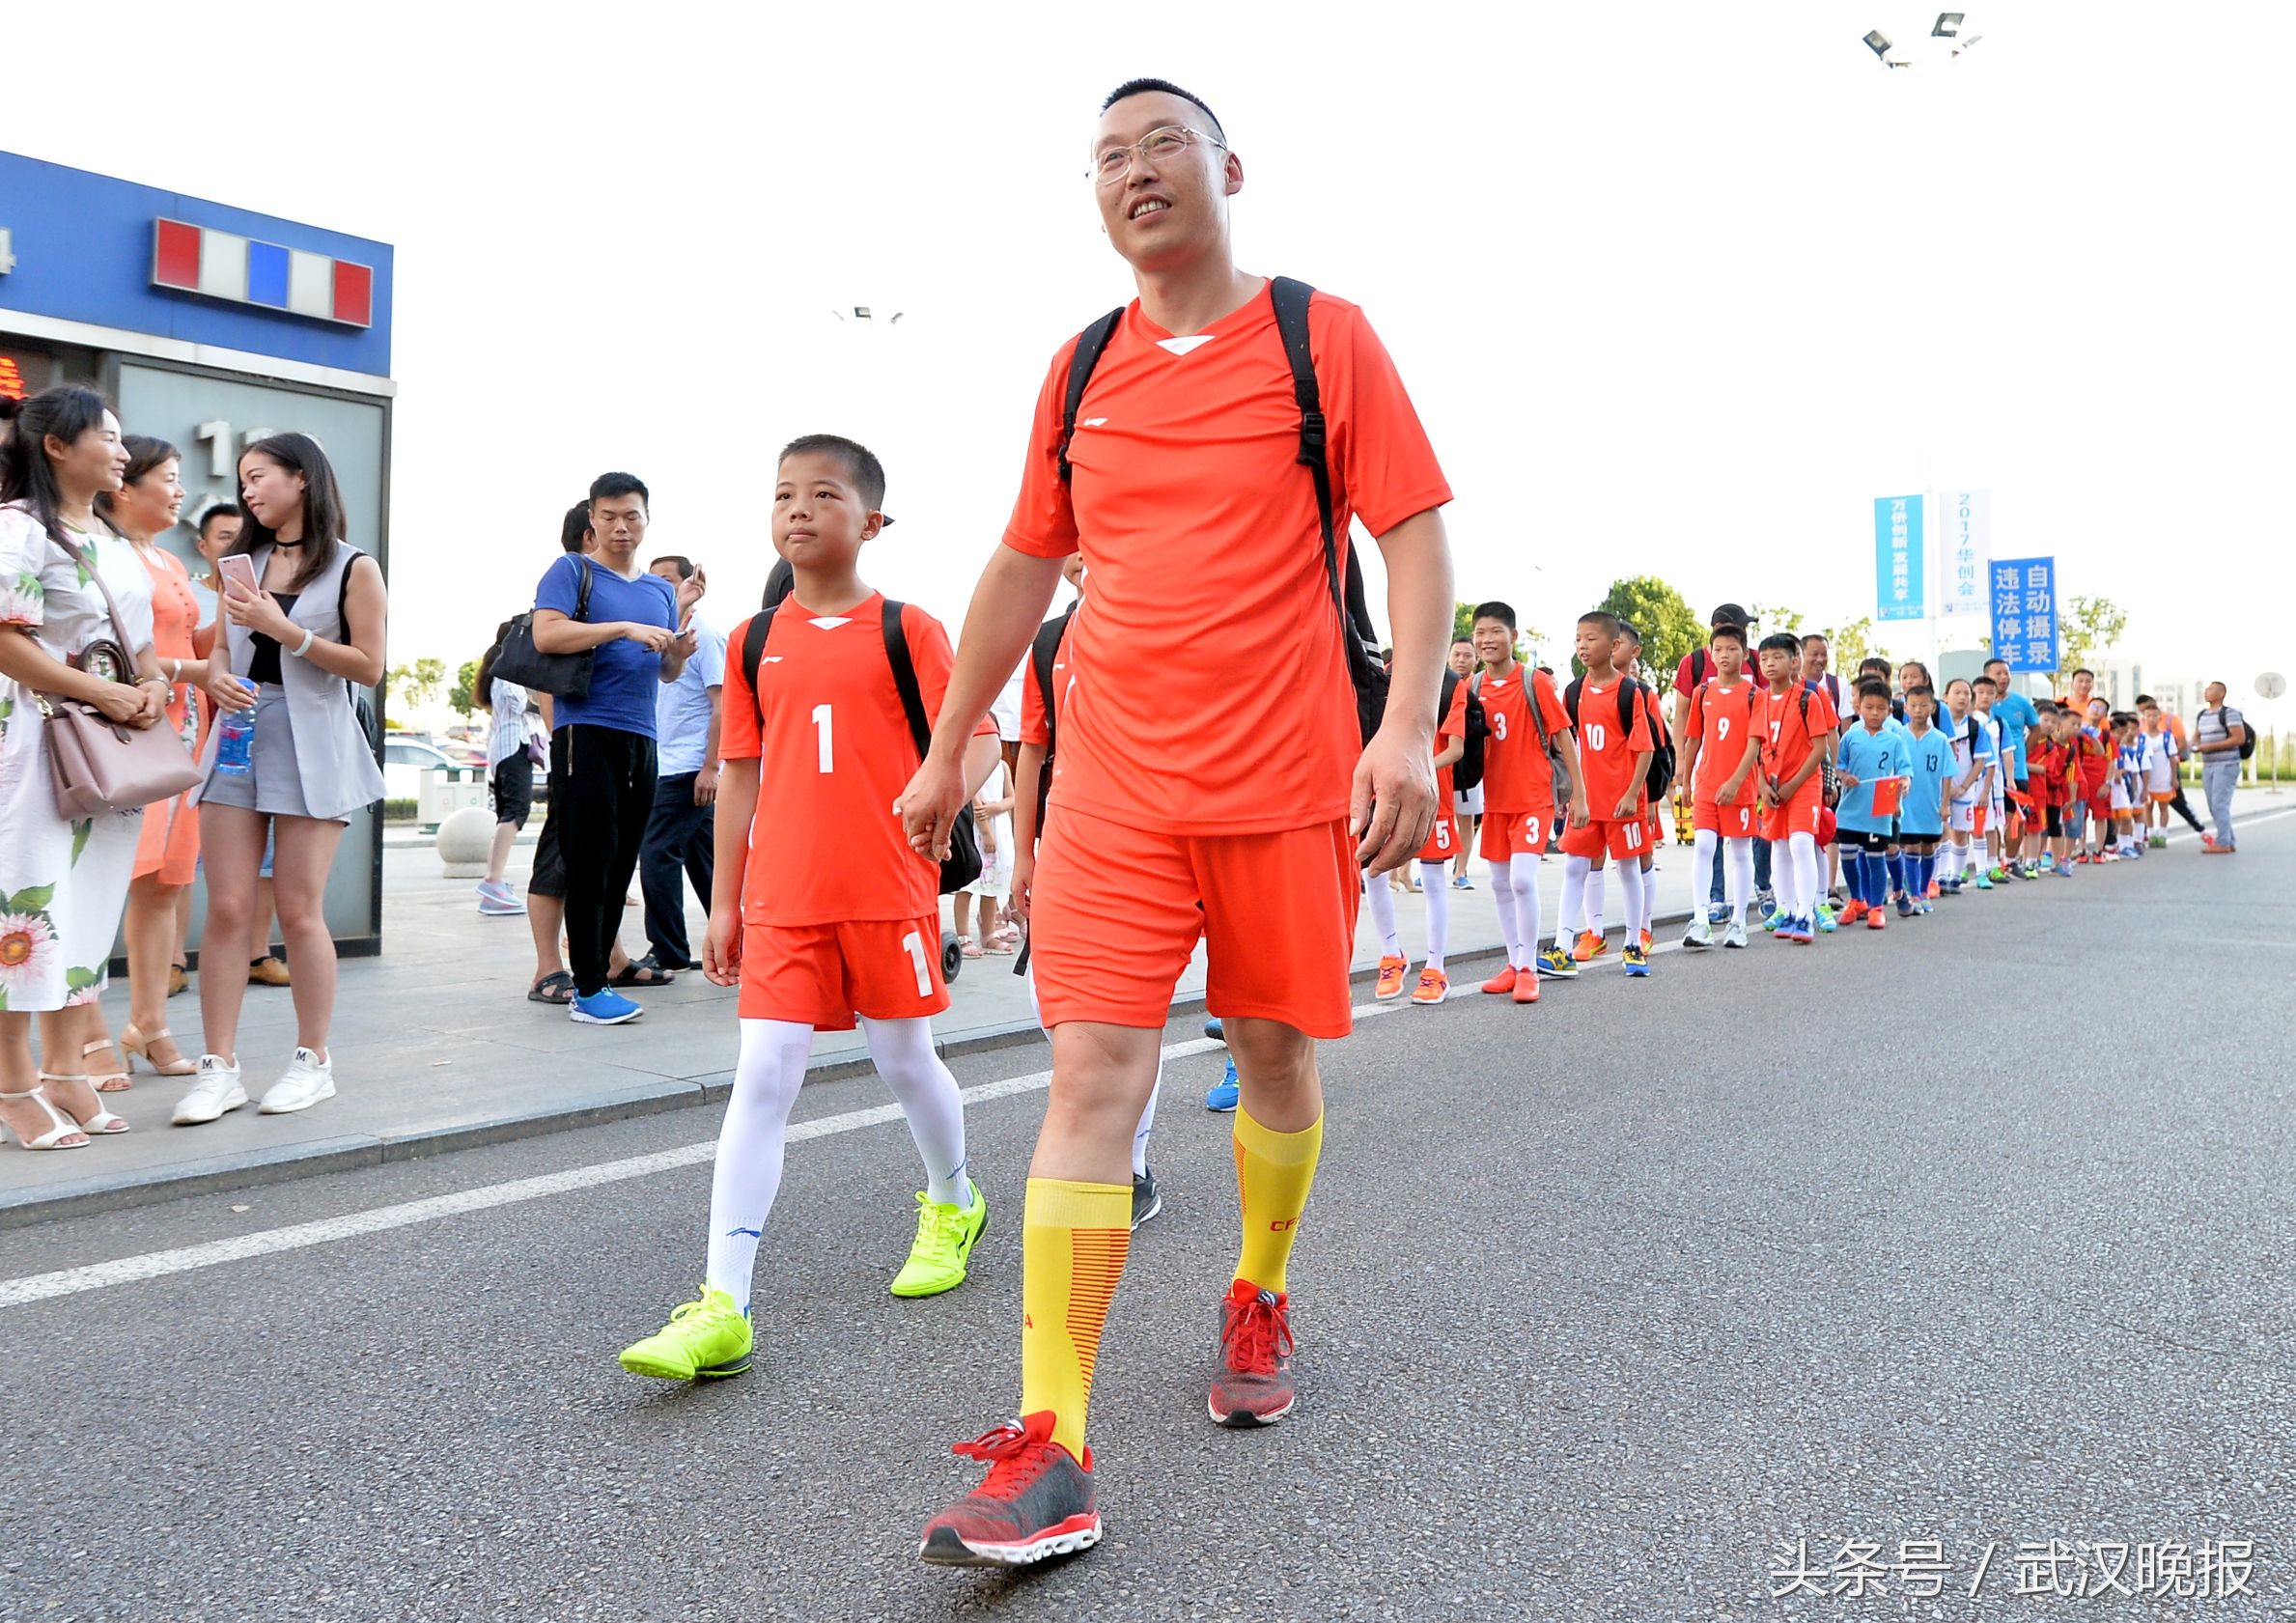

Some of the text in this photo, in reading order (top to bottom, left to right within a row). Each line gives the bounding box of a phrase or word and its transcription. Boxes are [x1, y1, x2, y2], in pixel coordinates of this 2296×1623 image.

[1957, 492, 1974, 596] 2017华创会
[1996, 567, 2023, 665] 违法停车
[2027, 565, 2051, 664] 自动摄录
[812, 704, 833, 773] 1
[1494, 713, 1507, 741] 3
[1585, 723, 1605, 751] 10
[1718, 717, 1730, 741] 9
[1770, 721, 1781, 743] 7
[1878, 751, 1889, 770] 2
[1925, 754, 1938, 772] 13
[1740, 807, 1750, 830] 9
[1811, 805, 1819, 827] 7
[1436, 820, 1449, 850] 5
[1526, 817, 1540, 845] 3
[1622, 822, 1642, 850] 10
[902, 931, 934, 997] 1
[202, 1058, 213, 1069] M
[295, 1049, 307, 1061] M
